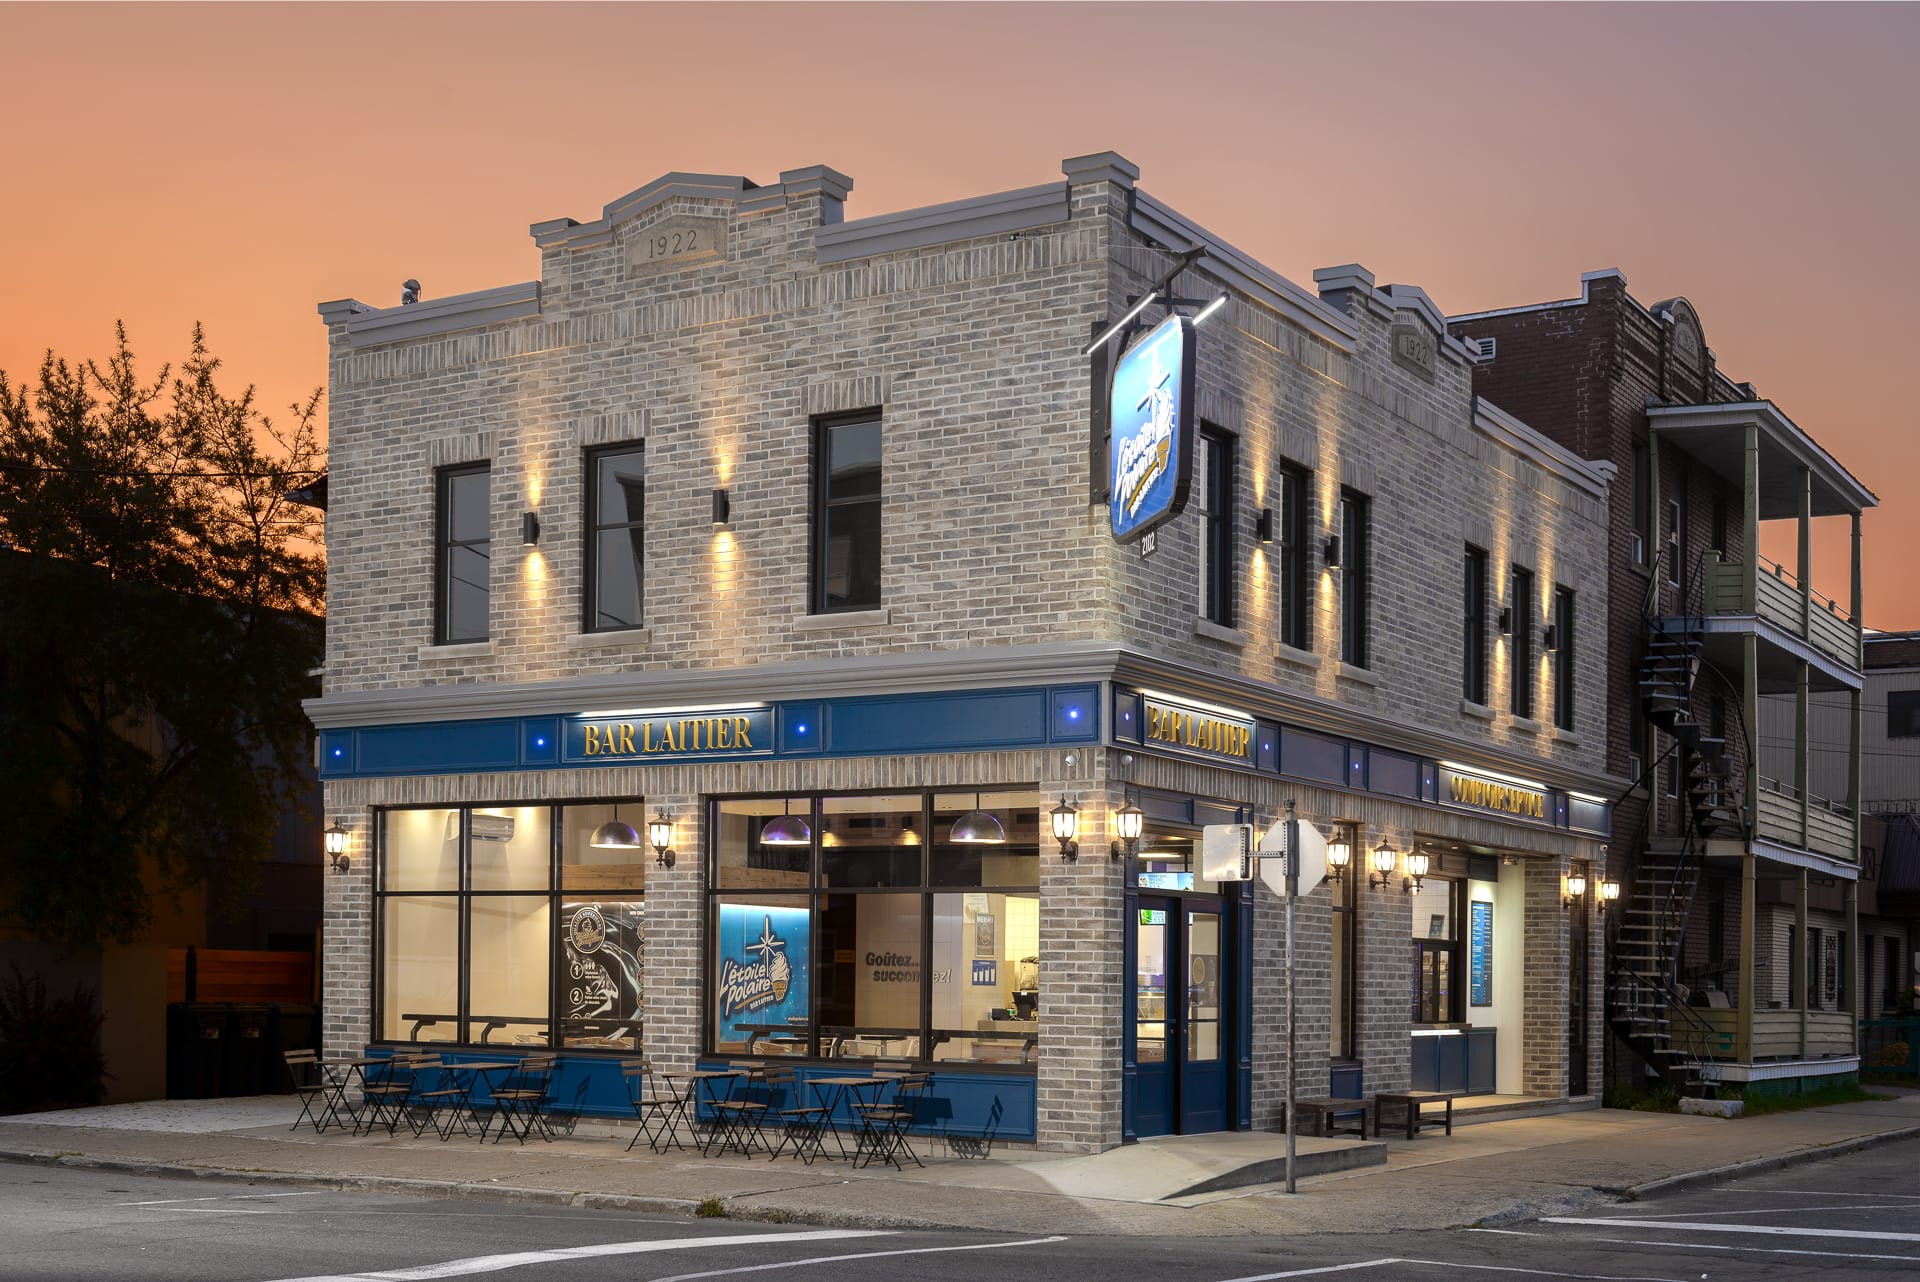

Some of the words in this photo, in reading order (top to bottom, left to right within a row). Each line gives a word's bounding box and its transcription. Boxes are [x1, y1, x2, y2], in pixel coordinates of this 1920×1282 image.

[649, 230, 697, 258] 1922
[1406, 336, 1427, 365] 1922
[1141, 531, 1155, 556] 2102
[584, 723, 637, 756] BAR
[642, 716, 752, 752] LAITIER
[1147, 704, 1183, 744] BAR
[1185, 712, 1251, 757] LAITIER
[1450, 774, 1505, 810] COMPTOIR
[1505, 786, 1544, 818] SERVICE
[719, 960, 766, 998] L'étoile
[725, 978, 771, 1016] polaire
